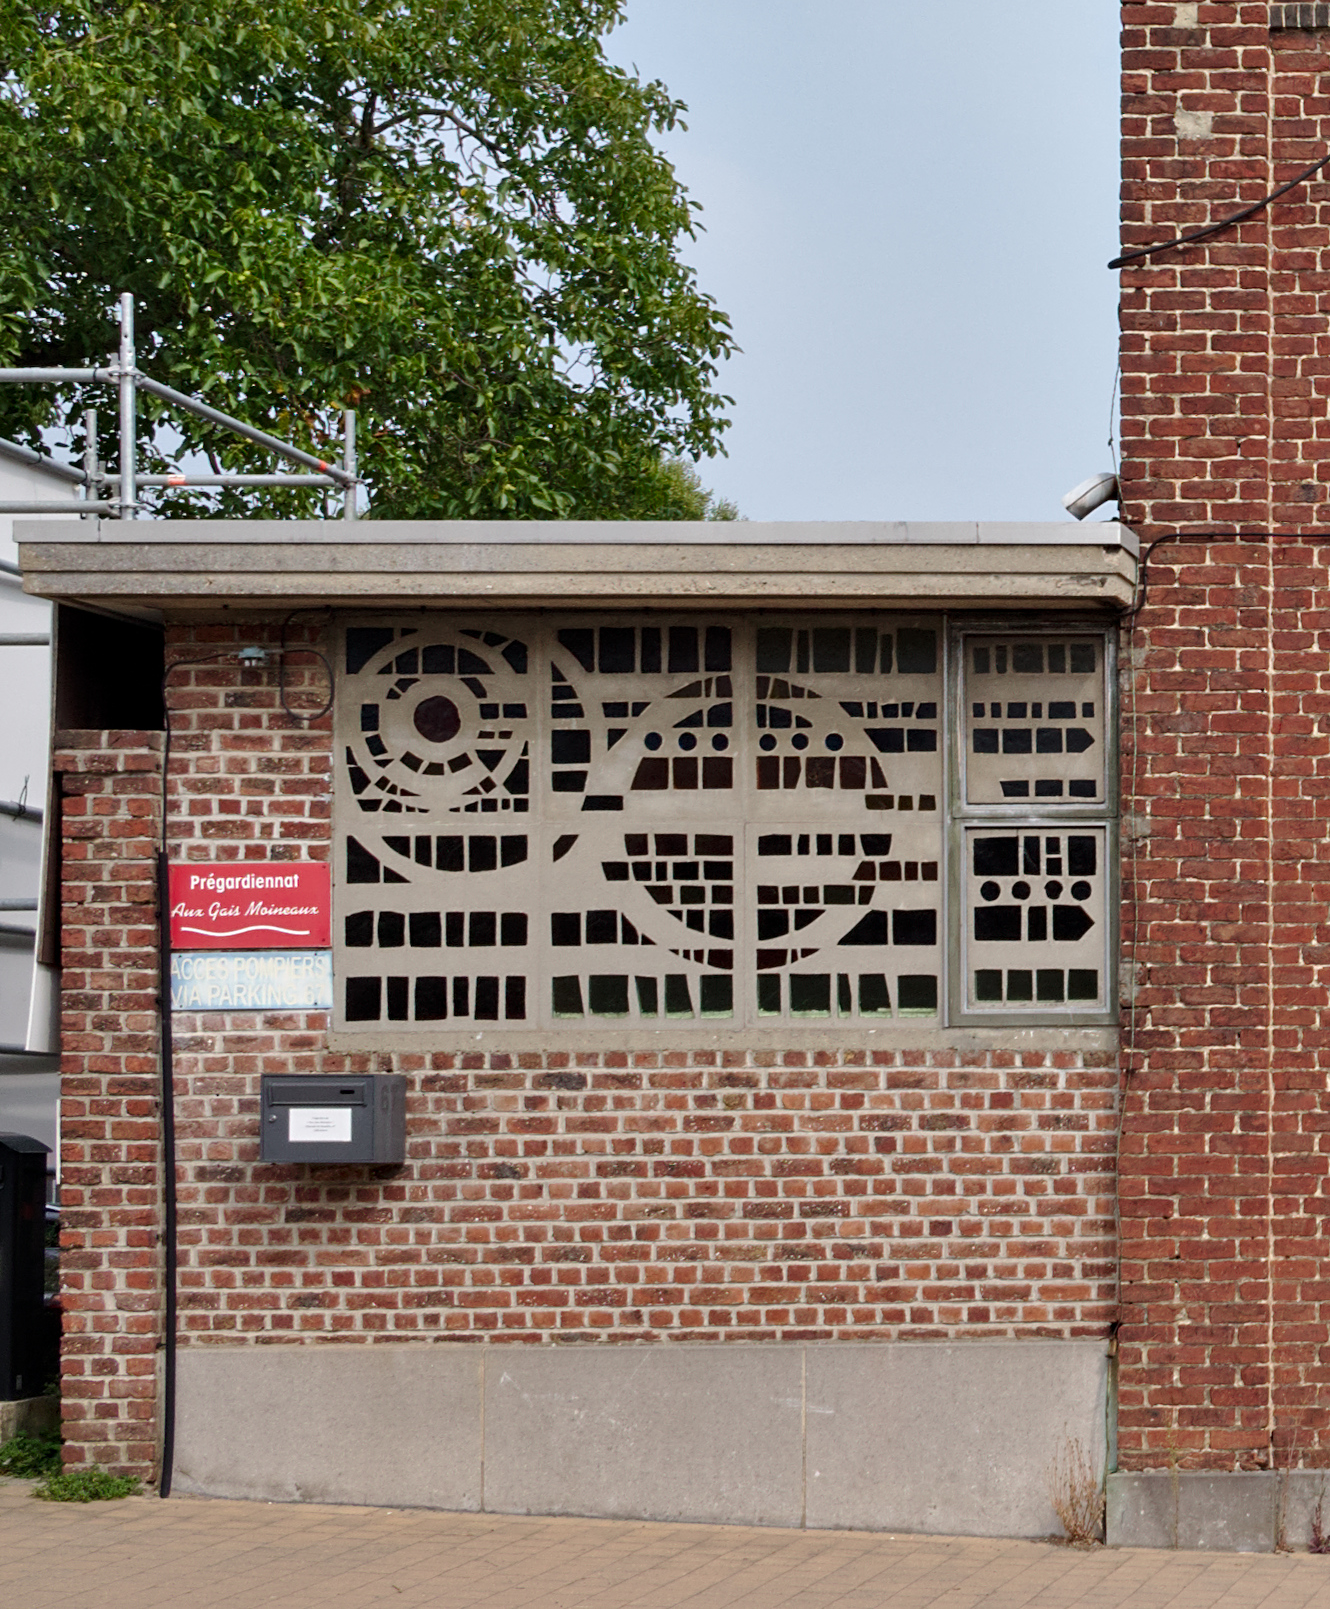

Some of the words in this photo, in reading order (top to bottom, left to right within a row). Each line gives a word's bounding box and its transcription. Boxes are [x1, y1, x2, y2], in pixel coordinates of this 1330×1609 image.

[190, 873, 299, 893] Prégardiennat
[171, 902, 204, 917] Aux
[208, 902, 241, 921] Gais
[245, 901, 319, 917] Moineaux
[171, 957, 229, 980] ACCES
[234, 956, 326, 979] POMPIERS
[171, 984, 202, 1007] VIA
[208, 984, 298, 1006] PARKING
[303, 984, 324, 1006] 67
